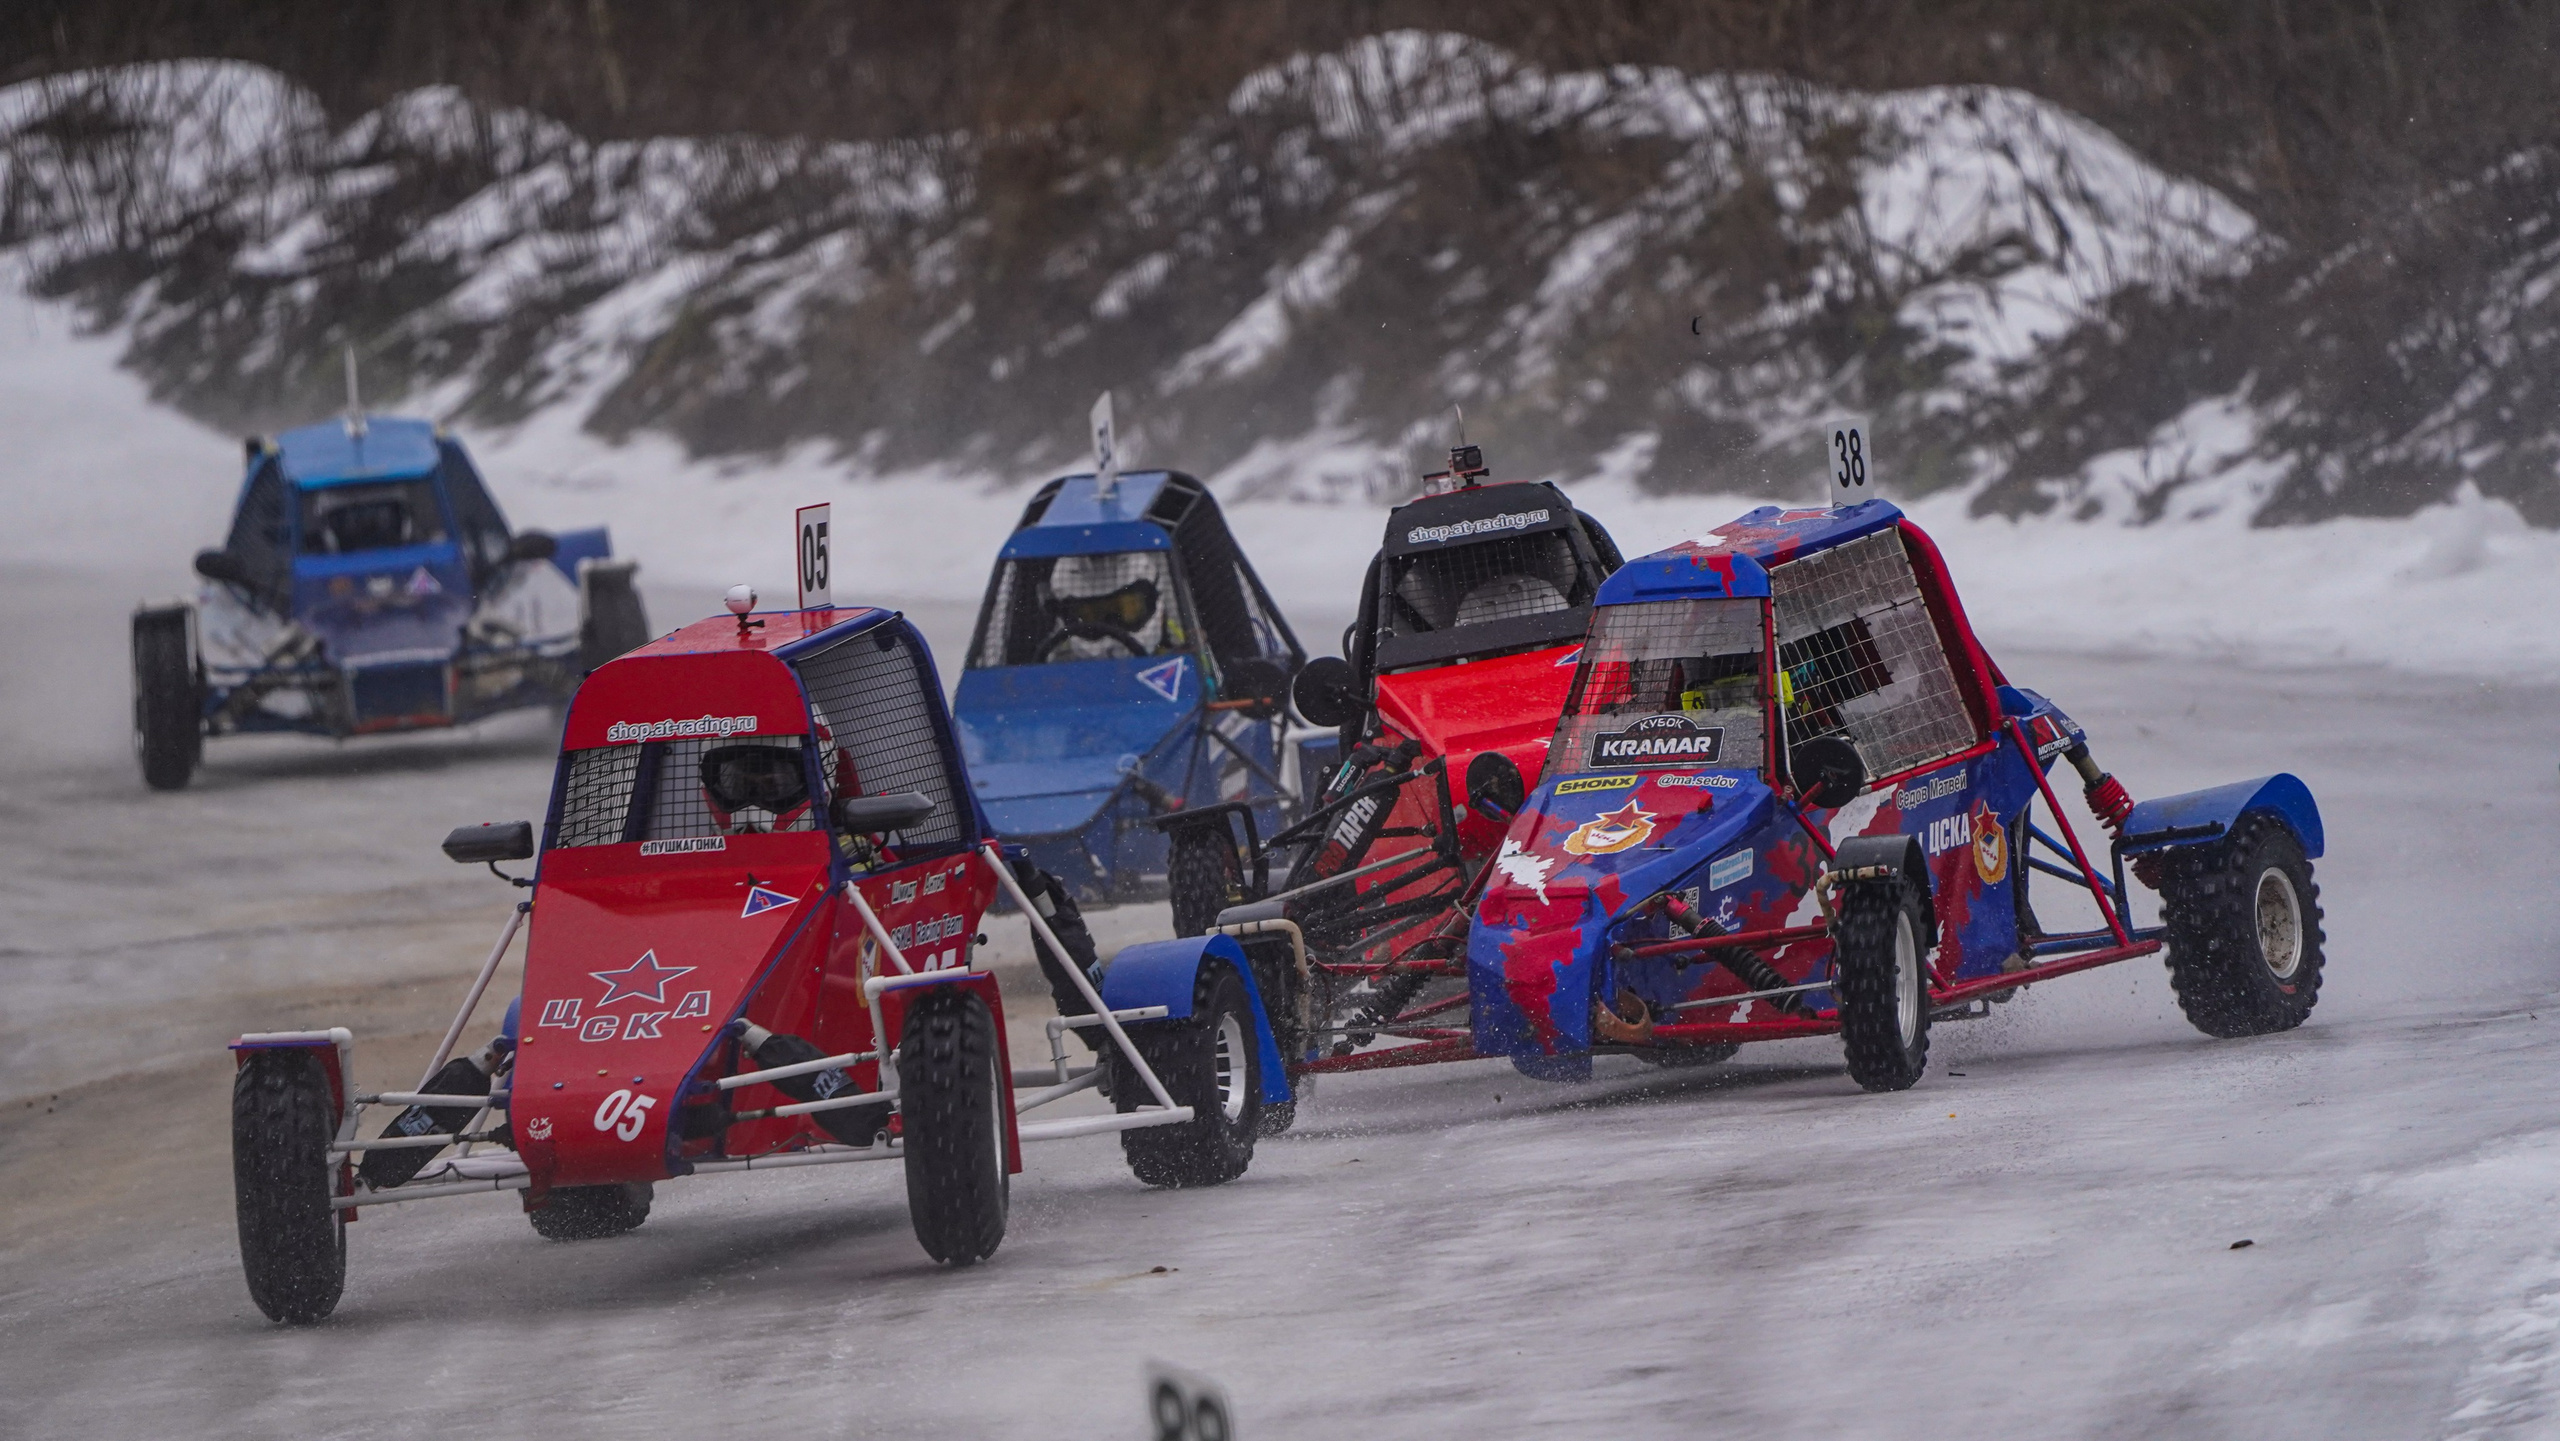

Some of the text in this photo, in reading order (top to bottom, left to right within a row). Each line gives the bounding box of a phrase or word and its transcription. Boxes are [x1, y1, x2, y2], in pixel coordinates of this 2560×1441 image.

[1835, 429, 1865, 488] 38
[1408, 509, 1549, 542] shop.at-racing.ru
[803, 522, 828, 592] 05
[607, 714, 757, 742] shop.at-racing.ru
[1640, 717, 1684, 731] КУБОК
[1602, 737, 1711, 757] KRAMAR
[1560, 778, 1631, 791] SHONX
[1658, 774, 1738, 788] @ma.sedov
[1896, 769, 1967, 810] Седов Матвей
[640, 837, 725, 856] #ПУШКАГОНКА
[1929, 812, 1971, 856] ЦСКА
[915, 918, 941, 946] Racing
[942, 913, 963, 938] Team
[538, 990, 711, 1042] ЦСКА
[594, 1089, 657, 1142] 05
